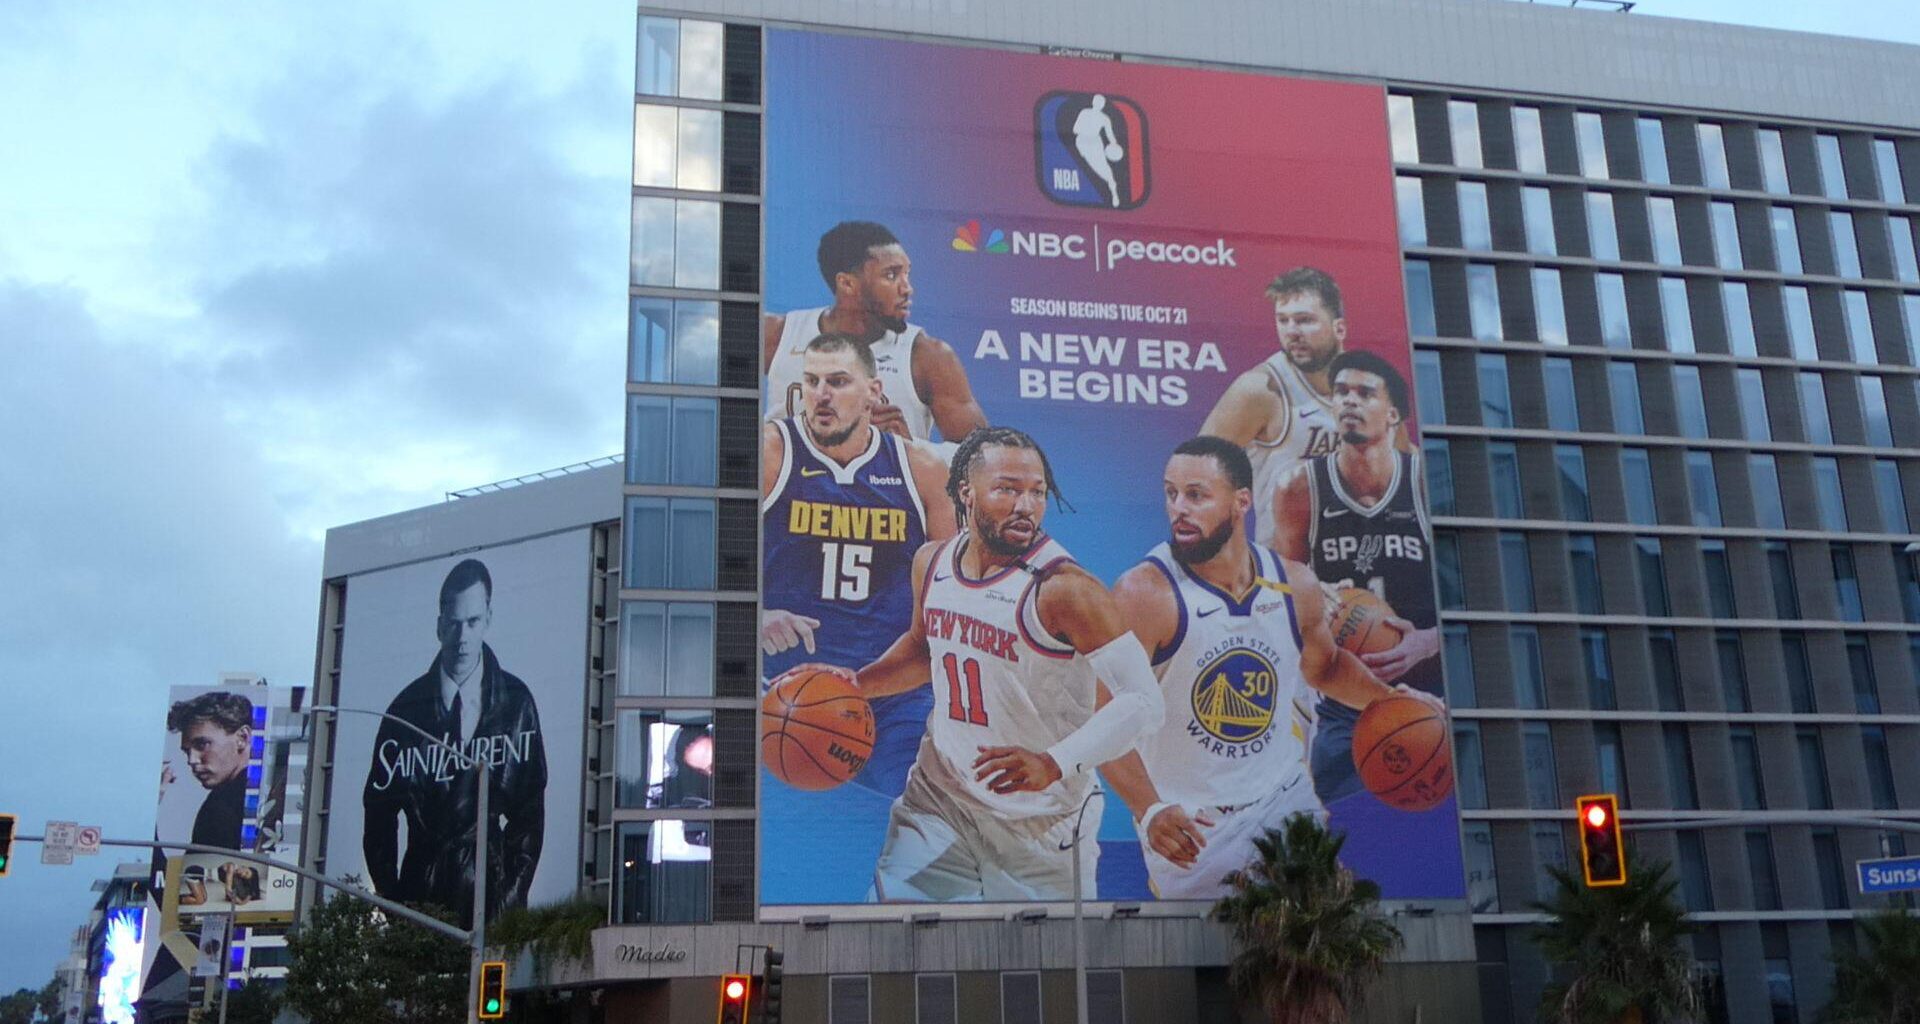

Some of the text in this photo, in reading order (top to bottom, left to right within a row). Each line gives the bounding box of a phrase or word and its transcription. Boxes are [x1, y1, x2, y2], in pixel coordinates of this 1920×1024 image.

[1054, 168, 1080, 191] NBA
[1012, 231, 1237, 269] NBC peacock
[1010, 297, 1187, 325] SEASON BEGINS TUE OCT 21
[974, 329, 1227, 372] A NEW ERA
[1019, 368, 1188, 406] BEGINS
[789, 499, 907, 542] DENVER
[821, 542, 873, 601] 15
[957, 613, 1019, 663] YORK
[1196, 636, 1281, 669] GOLDEN STATE
[942, 652, 989, 728] 11
[1240, 670, 1270, 698] 30
[373, 731, 536, 790] SAINT LAURENT
[272, 874, 294, 889] alo
[1868, 868, 1920, 886] Suns
